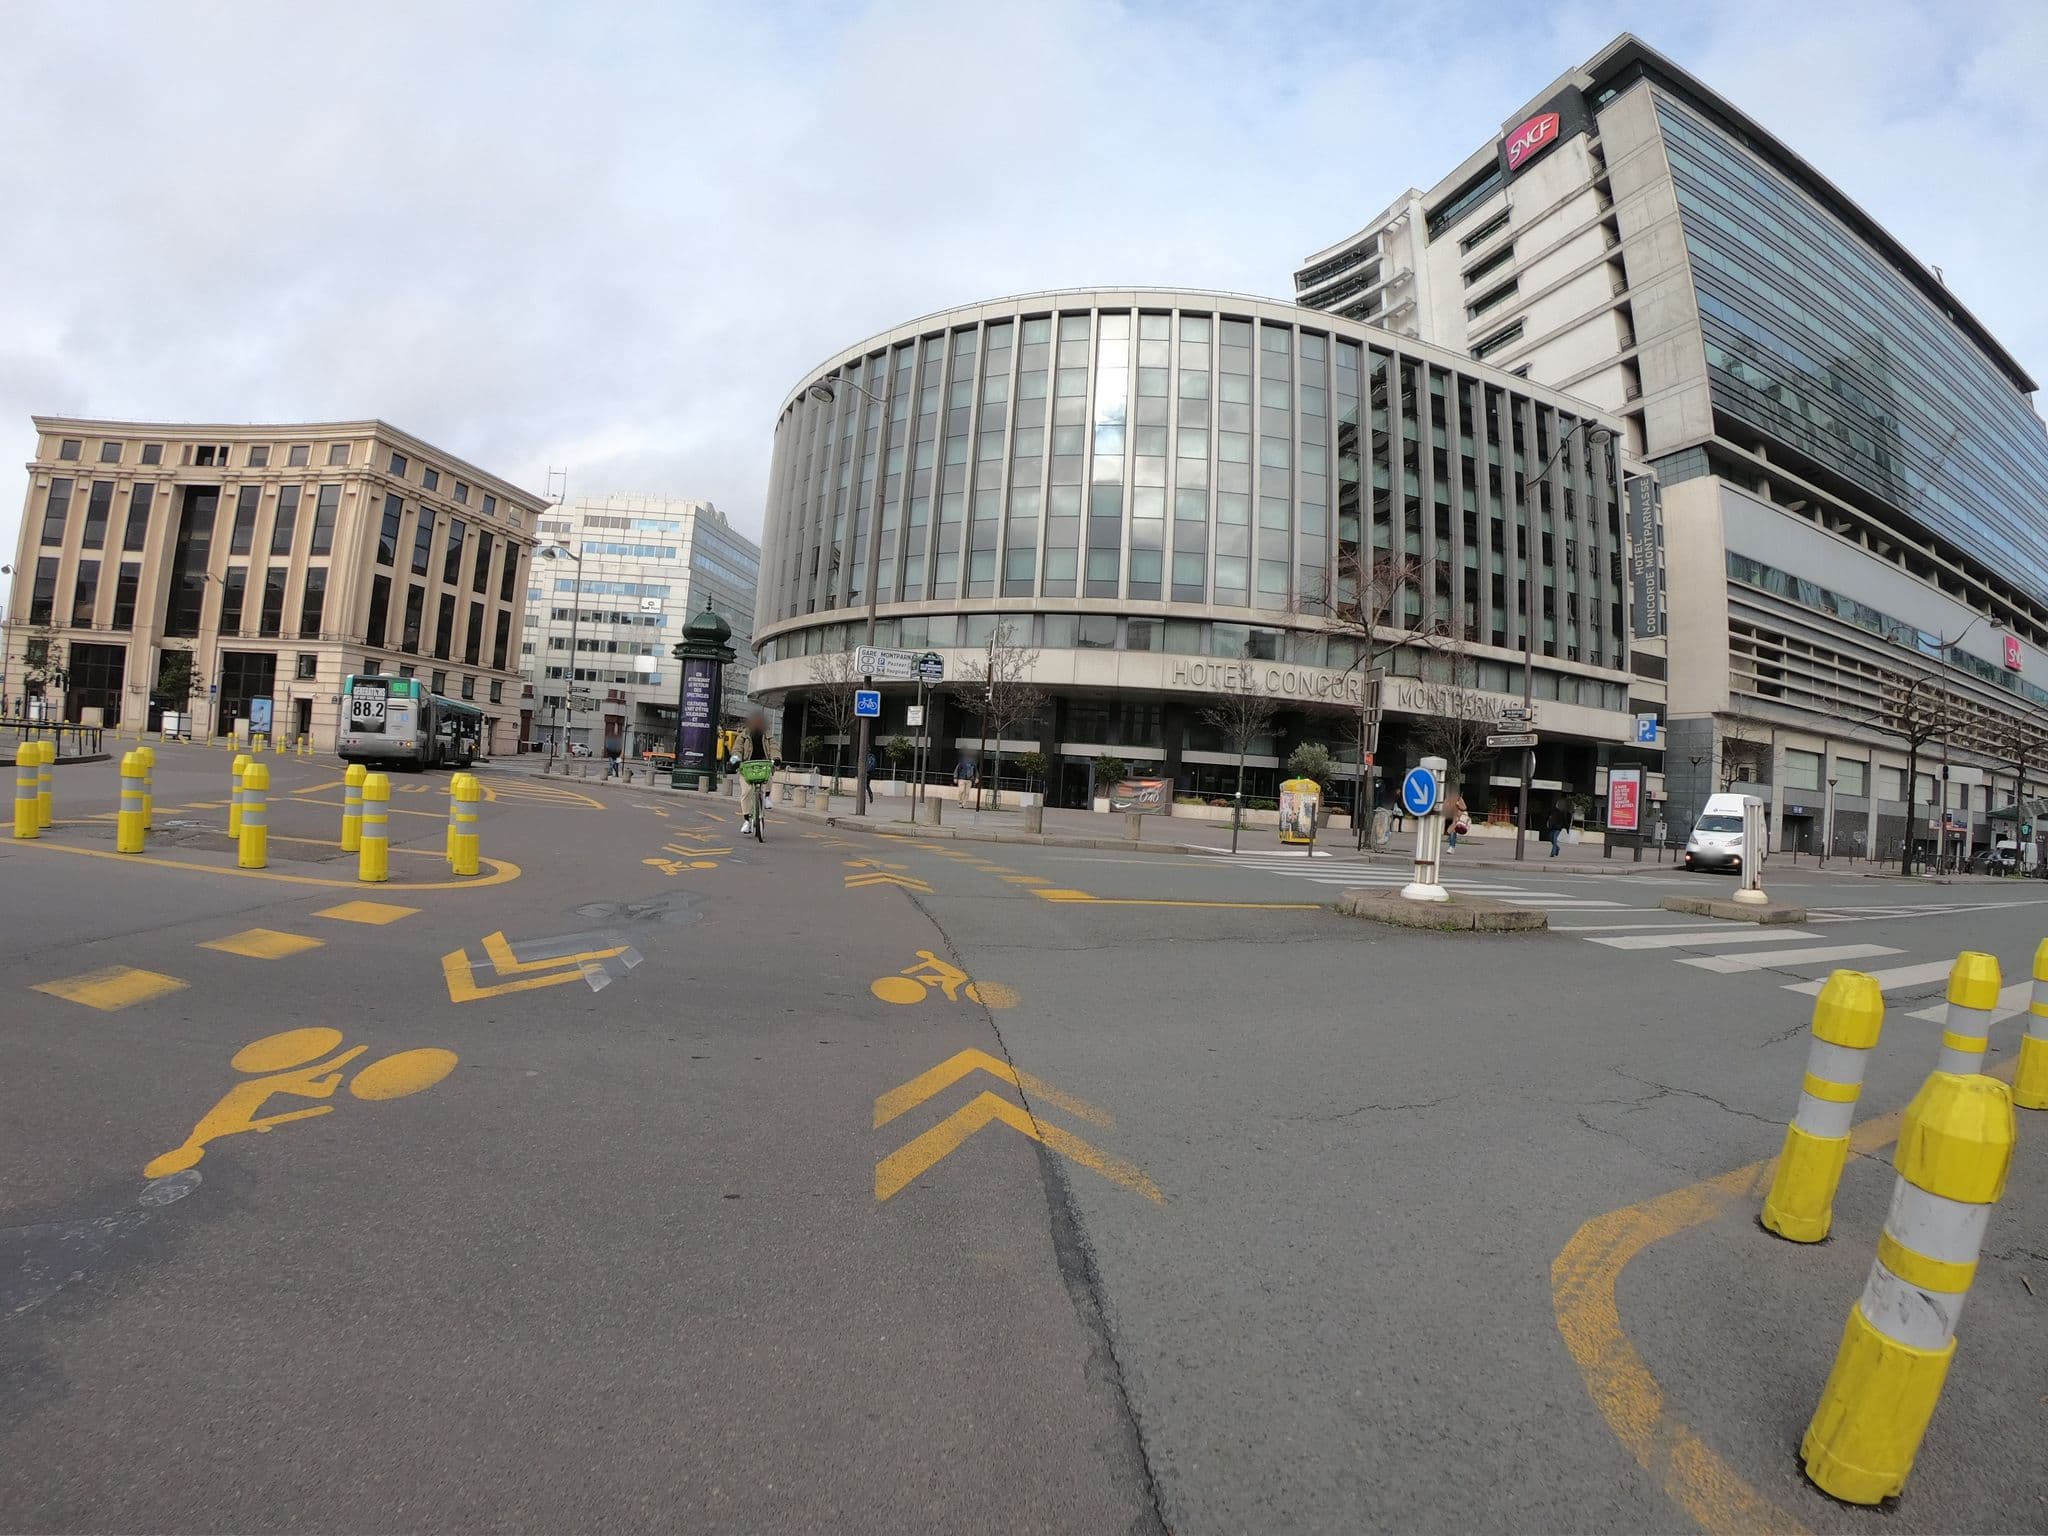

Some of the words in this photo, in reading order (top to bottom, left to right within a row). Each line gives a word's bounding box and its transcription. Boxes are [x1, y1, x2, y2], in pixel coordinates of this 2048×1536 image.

[1510, 115, 1554, 163] SNCF
[1640, 478, 1655, 569] MONTPARNASSE
[1634, 539, 1643, 575] HOTEL
[1645, 571, 1656, 633] CONCORDE
[862, 650, 878, 658] GARE
[1173, 660, 1253, 691] HOTEL
[353, 701, 384, 717] 88.2
[1639, 721, 1649, 737] P
